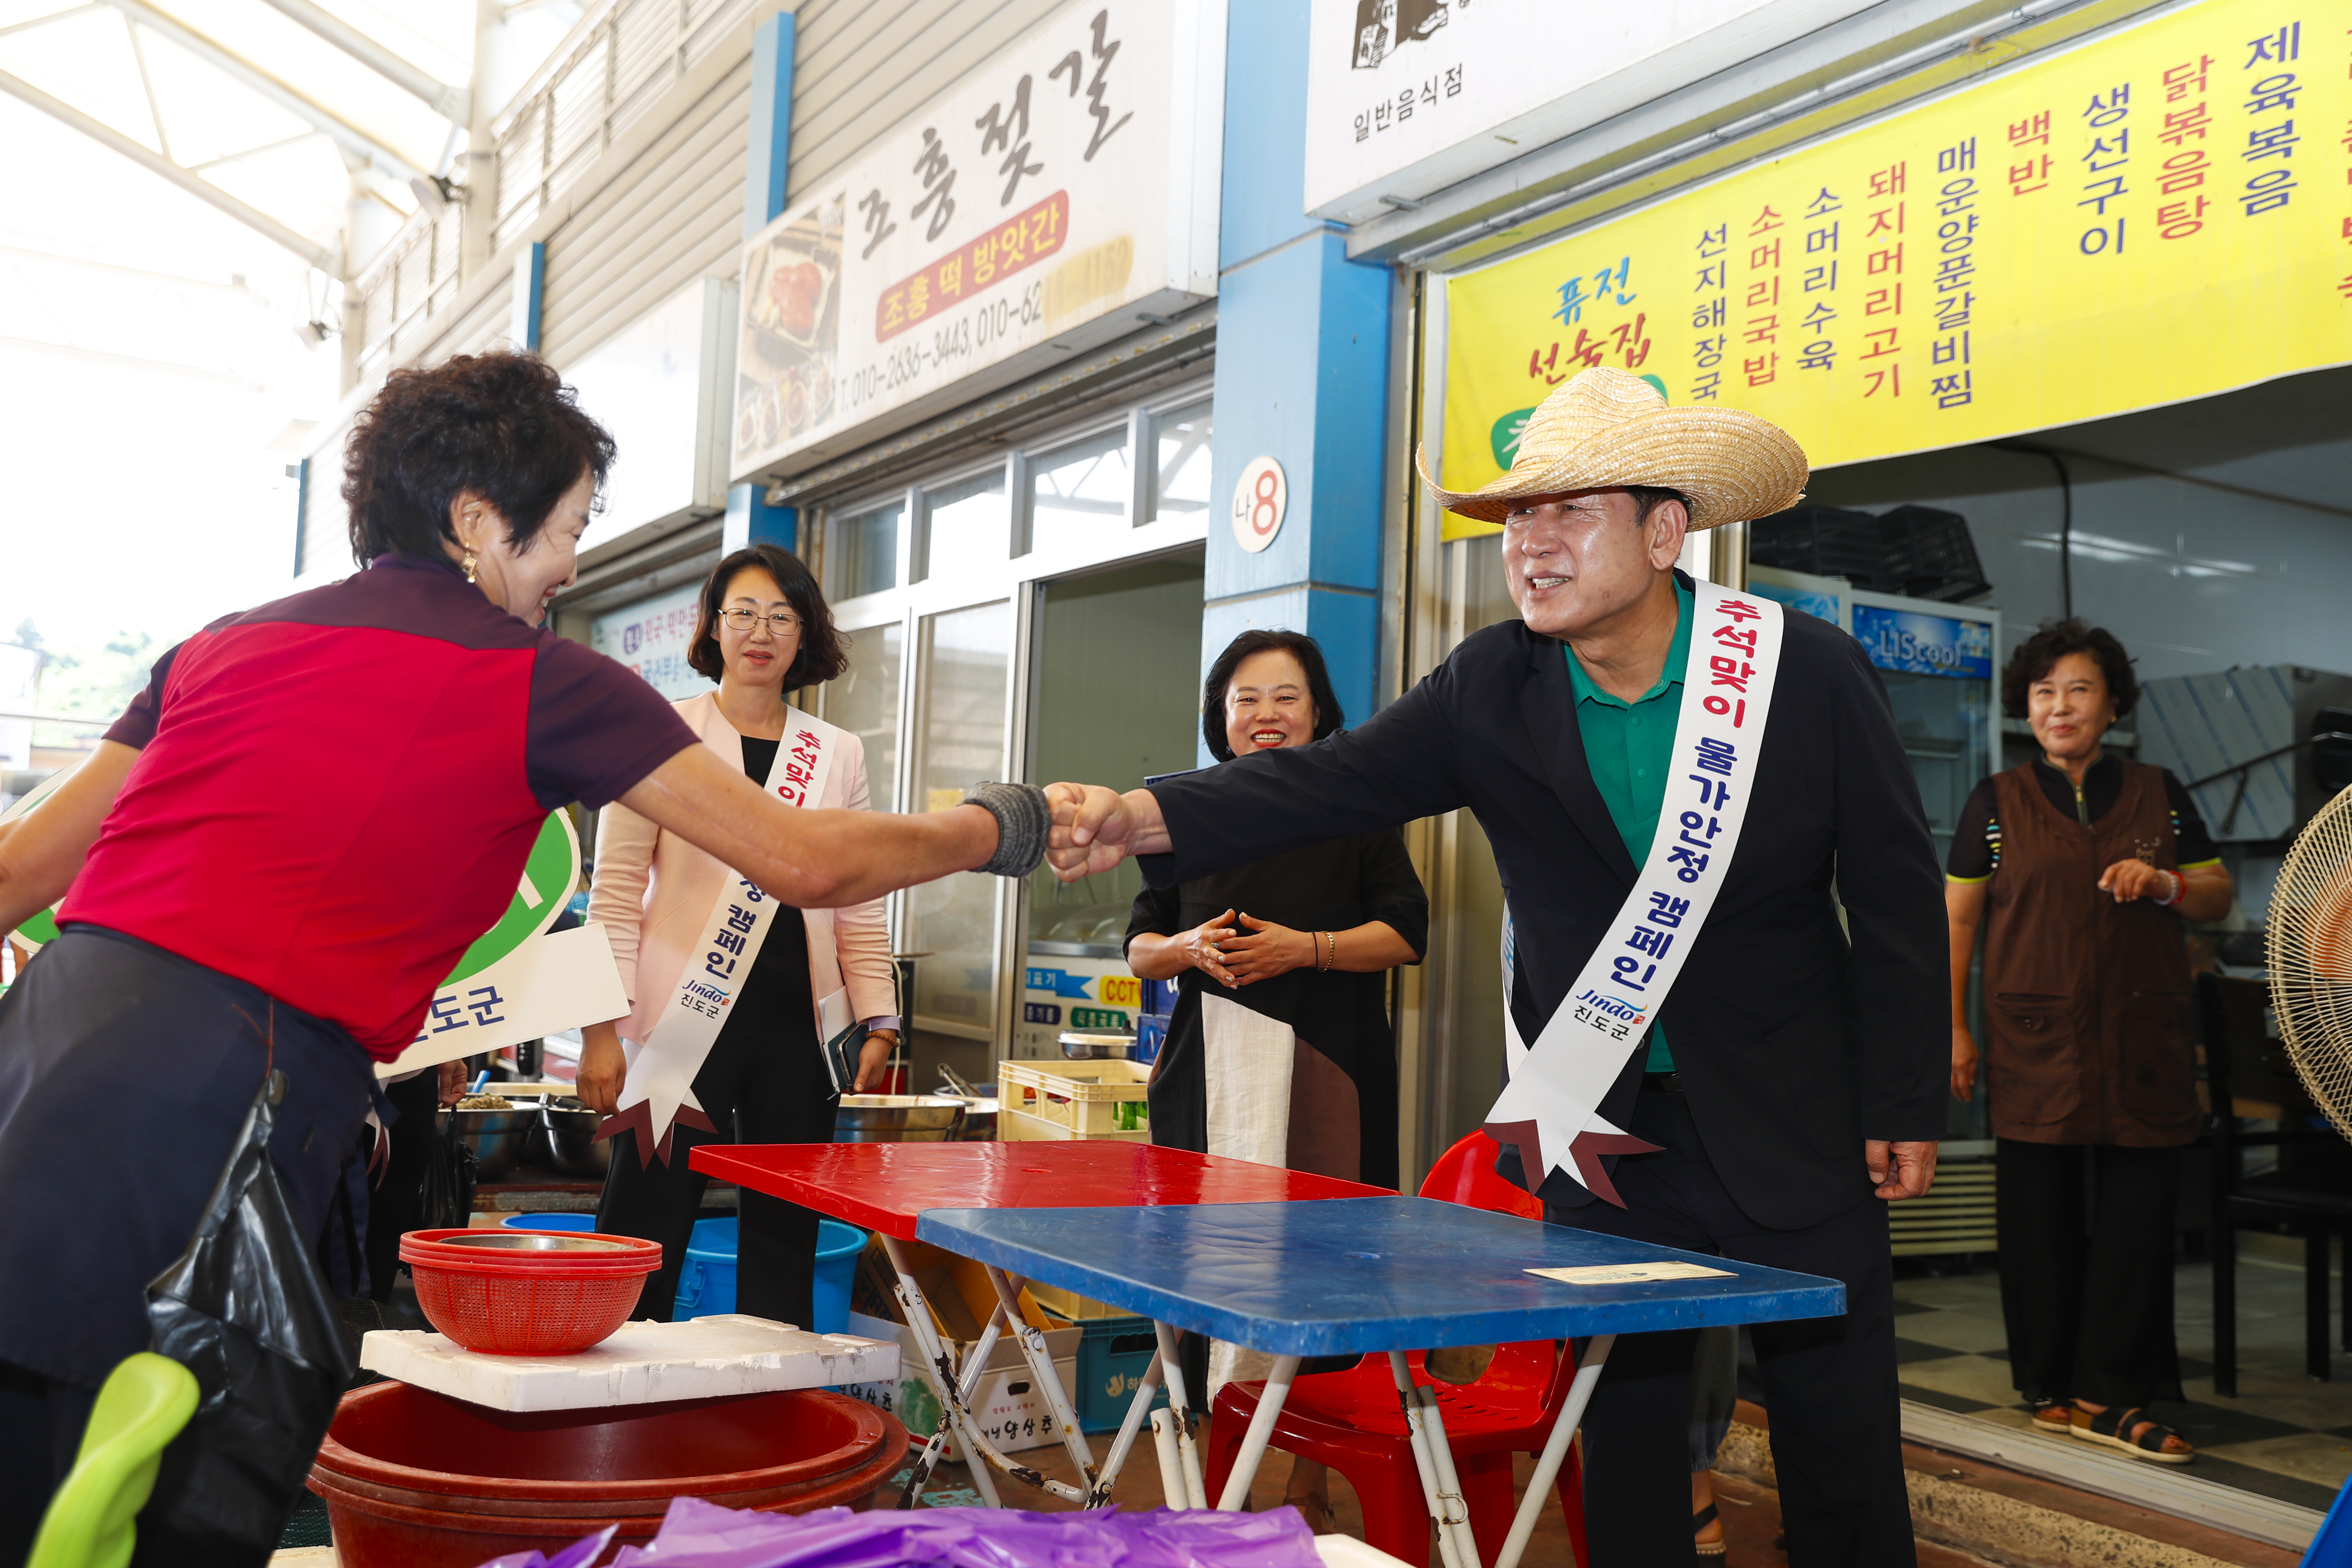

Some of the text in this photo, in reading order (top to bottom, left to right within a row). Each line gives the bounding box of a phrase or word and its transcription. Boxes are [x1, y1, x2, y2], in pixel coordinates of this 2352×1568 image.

[1354, 62, 1462, 144] 일반음식점
[2007, 110, 2055, 197] 백반
[2076, 82, 2130, 257] 생선구이
[2156, 54, 2216, 241] 닭볶음탕
[881, 202, 1060, 332] 조흥 떡 방앗간
[1552, 256, 1637, 326] 퓨전
[1743, 204, 1784, 388] 소머리국밥
[1796, 186, 1843, 371] 소머리수육
[1859, 161, 1906, 398] 돼지머리고기
[1930, 136, 1979, 410] 매운양푼갈비찜
[1690, 223, 1727, 401] 선지해장국
[778, 729, 821, 808] 추석맞이
[1610, 600, 1761, 991] 추석맞이 물가안정 캠페인
[705, 904, 756, 980] 캠페인
[412, 985, 505, 1044] 도군
[681, 993, 719, 1019] 진도군
[682, 980, 723, 1003] Jindo
[1105, 980, 1142, 1002] CCT
[1574, 1005, 1630, 1041] 진도군
[1575, 989, 1634, 1020] Jindo
